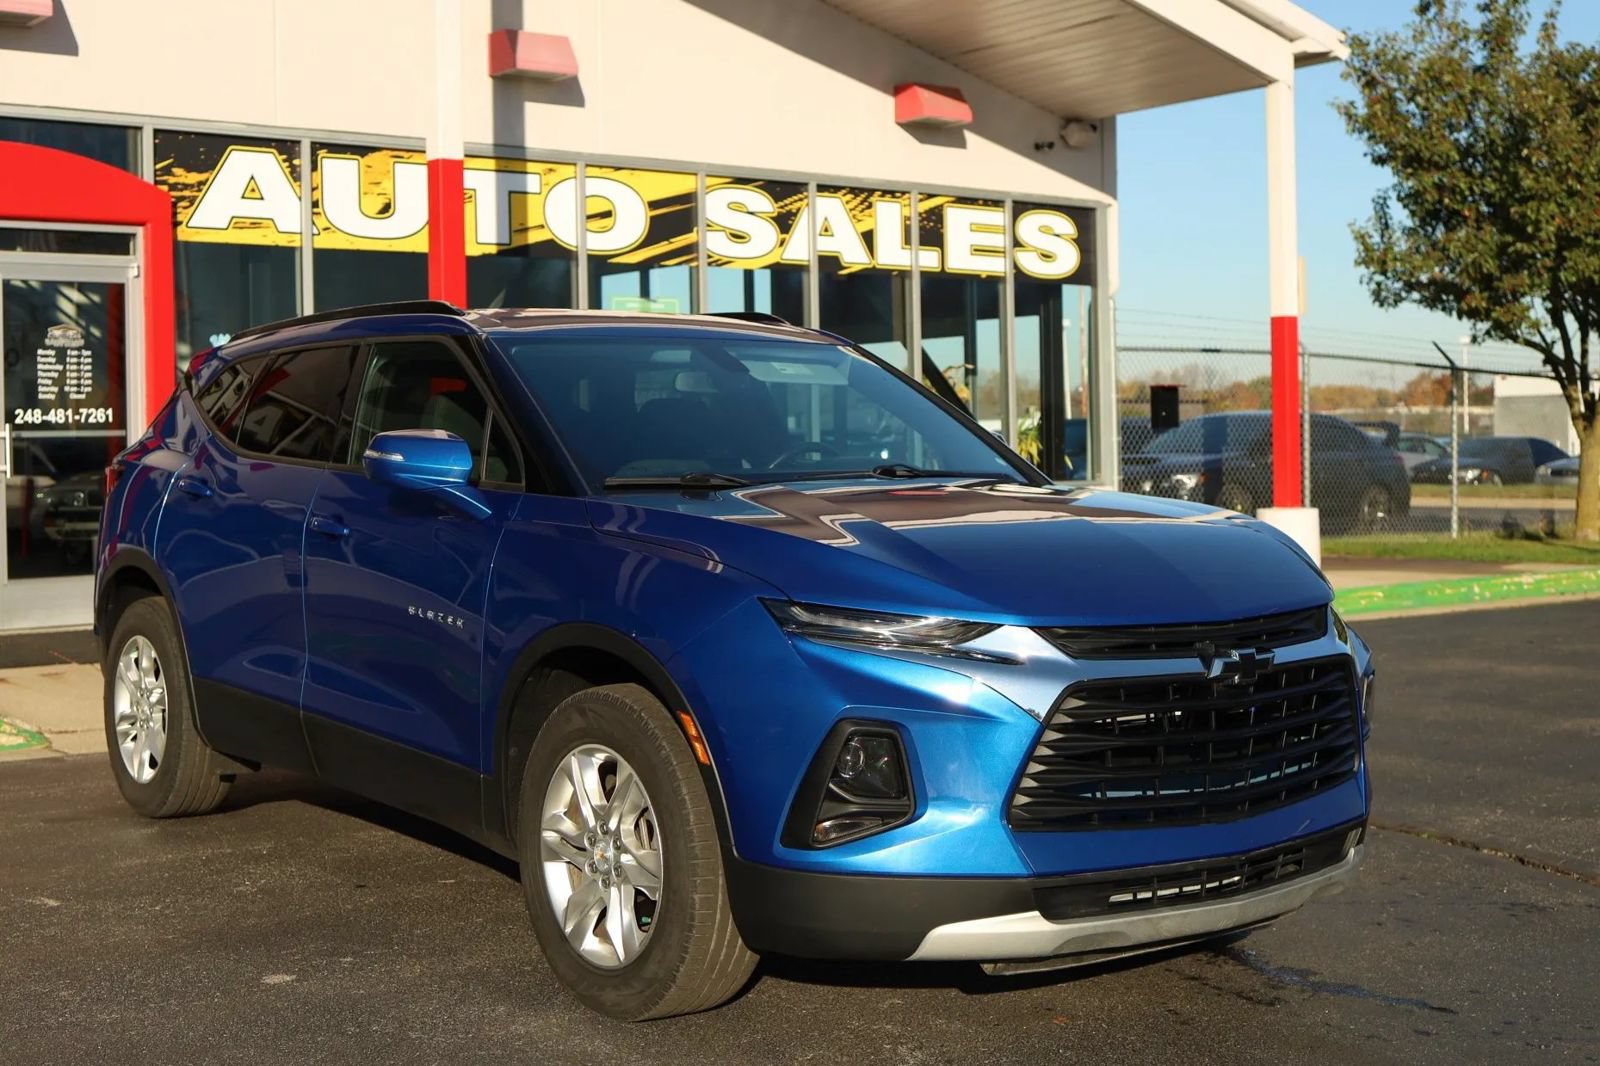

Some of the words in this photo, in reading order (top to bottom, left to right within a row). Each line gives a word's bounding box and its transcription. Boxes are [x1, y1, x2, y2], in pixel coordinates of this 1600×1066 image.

[184, 145, 650, 254] AUTO
[702, 185, 1081, 279] SALES
[14, 407, 113, 424] 248-481-7261
[408, 605, 464, 629] BLAZER
